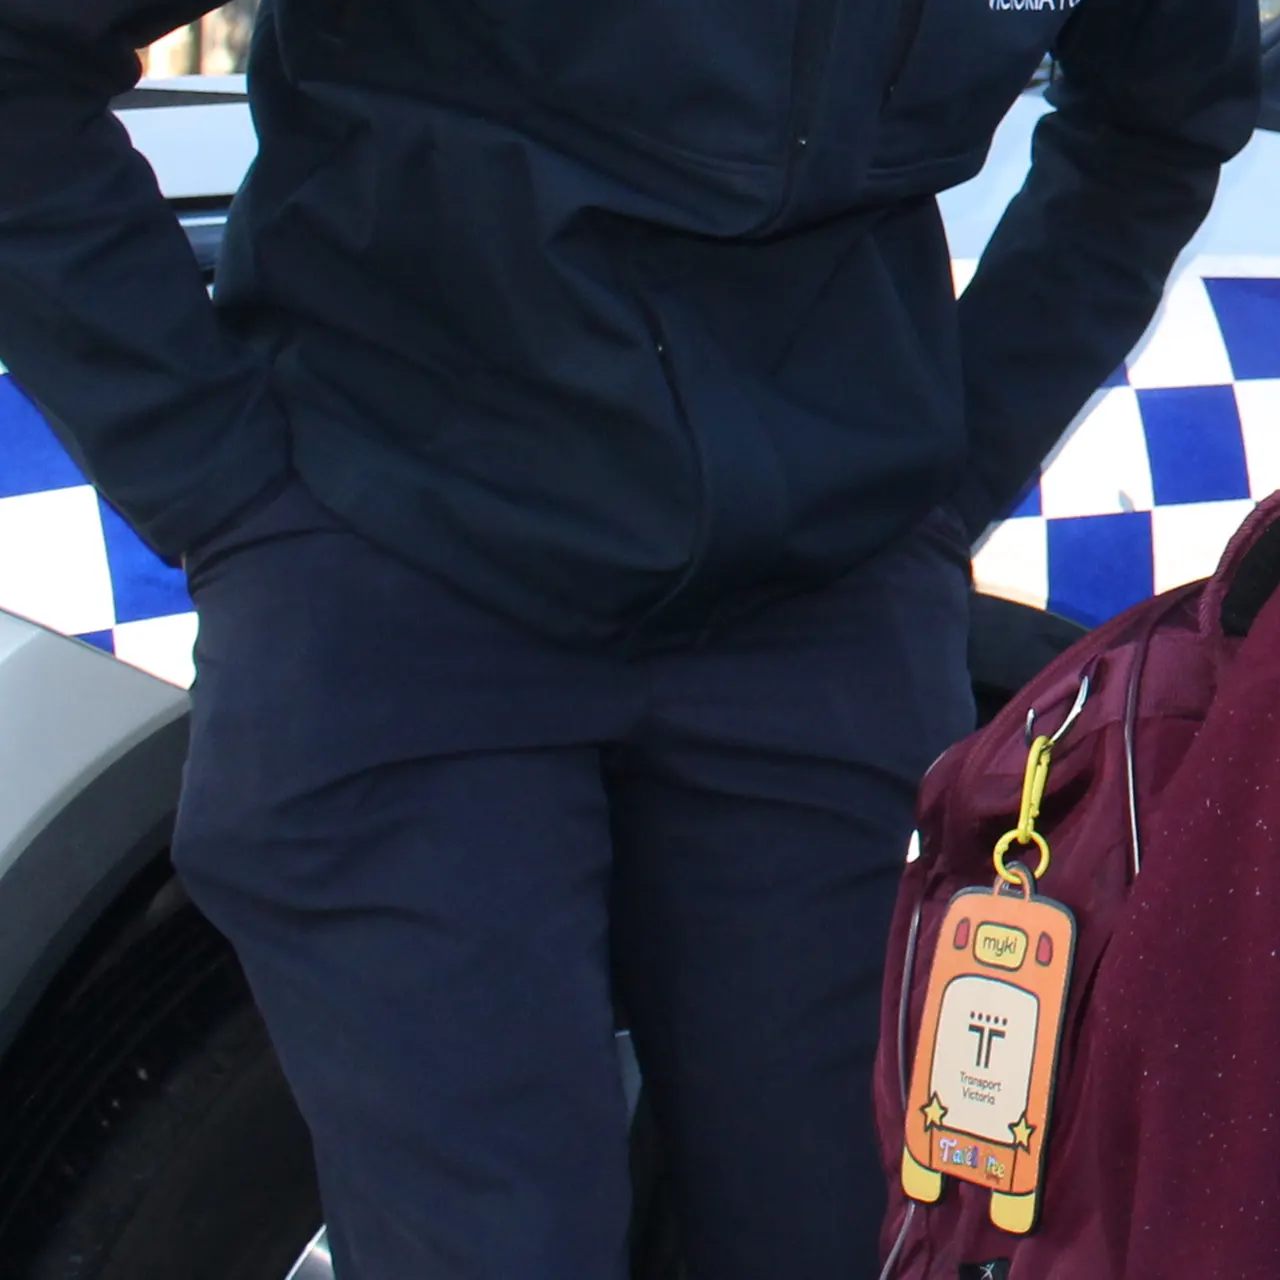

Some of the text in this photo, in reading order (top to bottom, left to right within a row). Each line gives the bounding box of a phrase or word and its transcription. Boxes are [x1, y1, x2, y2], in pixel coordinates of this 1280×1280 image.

[982, 936, 1018, 957] myki
[960, 1071, 1002, 1092] Transport
[962, 1086, 996, 1105] Victoria
